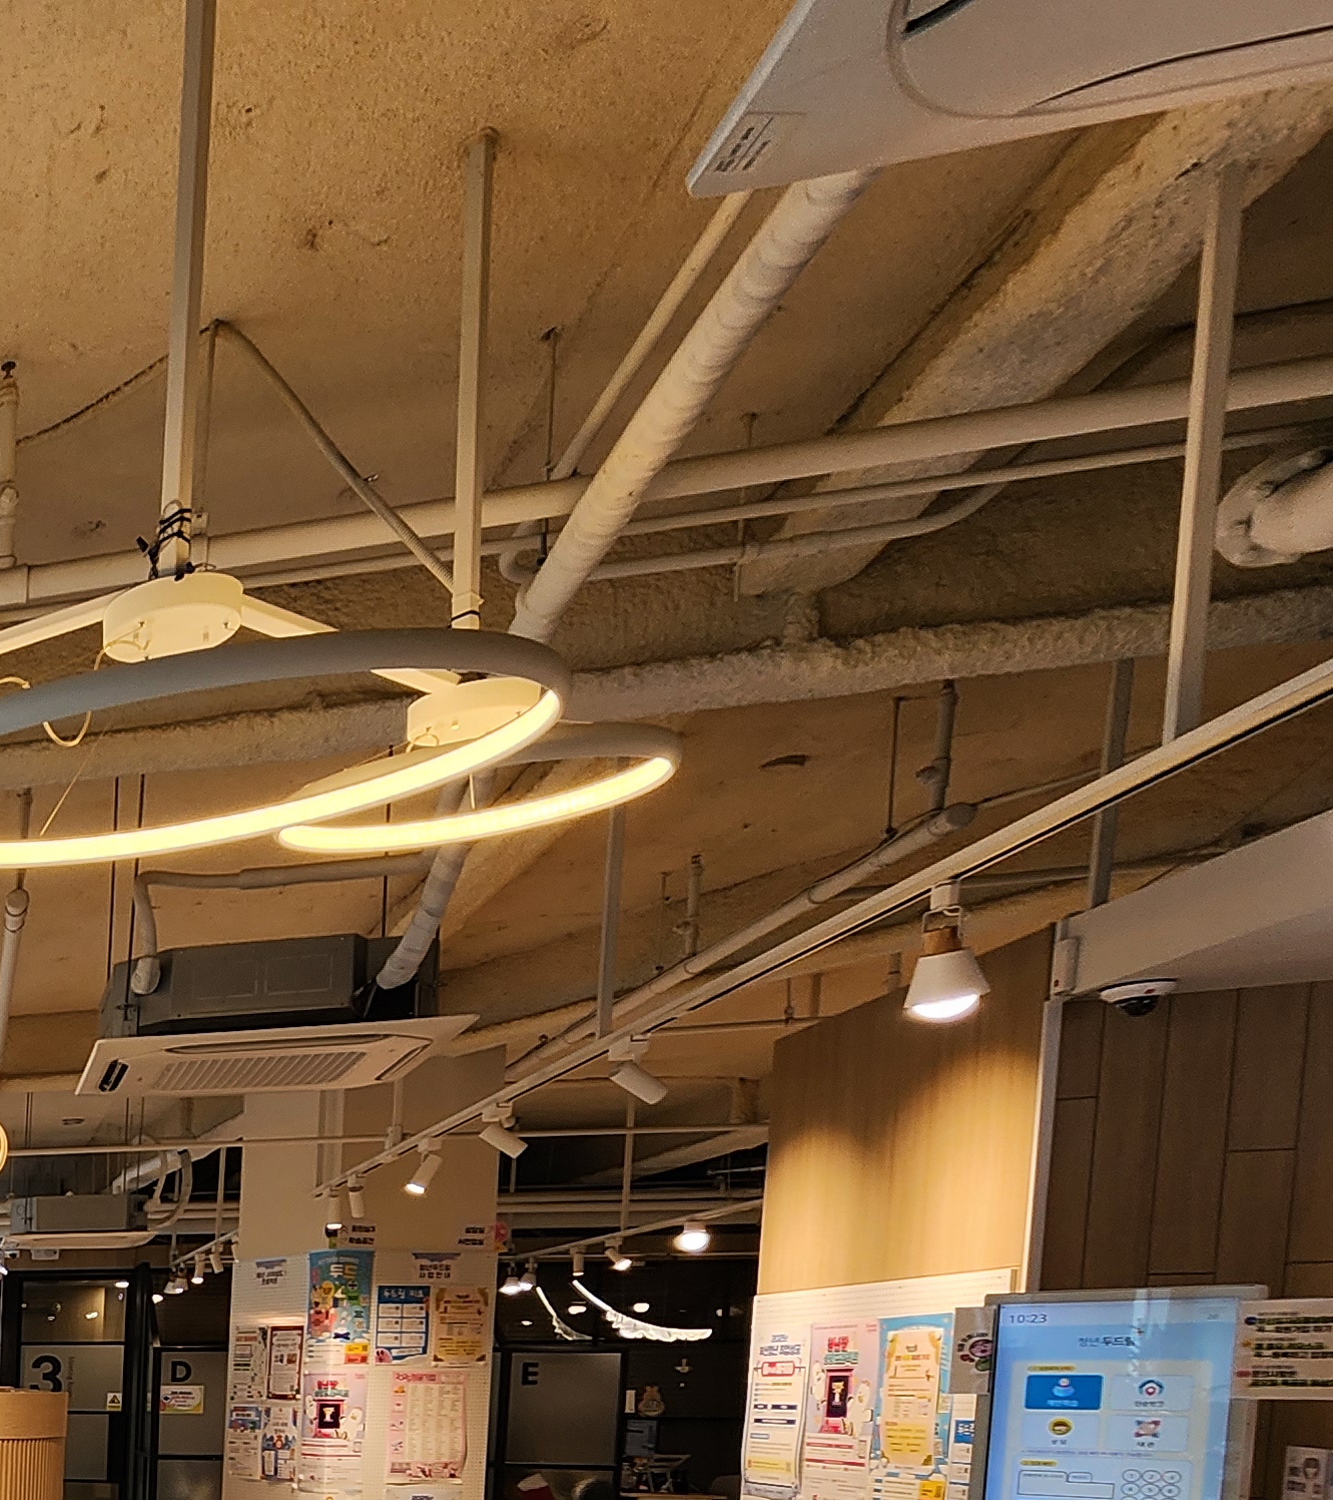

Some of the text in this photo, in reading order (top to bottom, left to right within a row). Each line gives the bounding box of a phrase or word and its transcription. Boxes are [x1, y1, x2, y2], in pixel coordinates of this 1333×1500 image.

[1009, 1313, 1048, 1324] 10:23
[30, 1354, 63, 1393] 3
[171, 1360, 192, 1383] D
[521, 1362, 539, 1385] E
